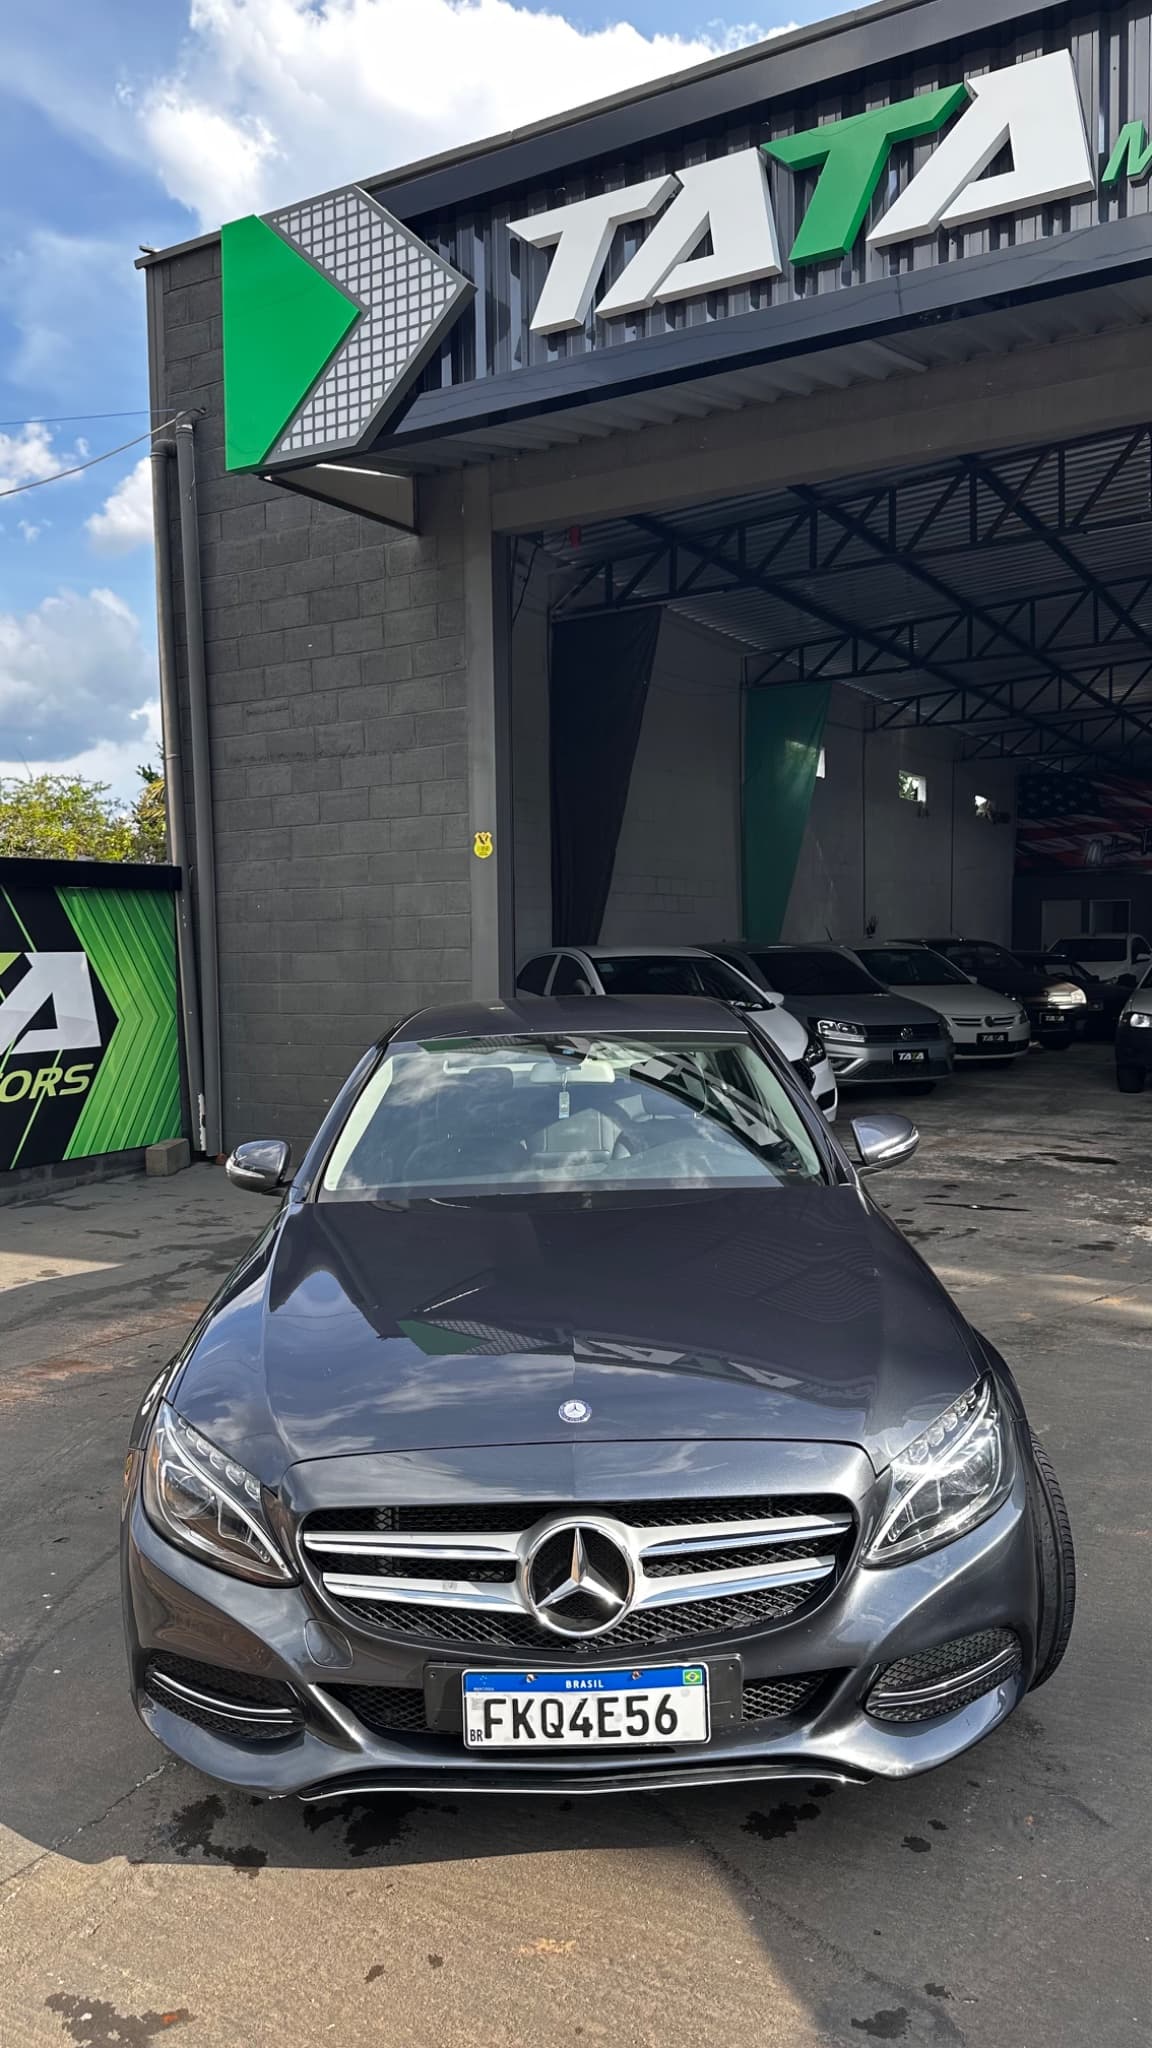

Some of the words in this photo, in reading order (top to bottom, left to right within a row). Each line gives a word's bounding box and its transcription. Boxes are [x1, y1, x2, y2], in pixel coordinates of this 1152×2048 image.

[506, 48, 1097, 336] TATA
[0, 951, 101, 1055] A
[897, 1052, 925, 1061] TATA
[0, 1063, 94, 1103] ORS
[565, 1679, 604, 1689] BRASIL
[470, 1729, 483, 1742] BR
[483, 1694, 678, 1739] FKQ4E56
